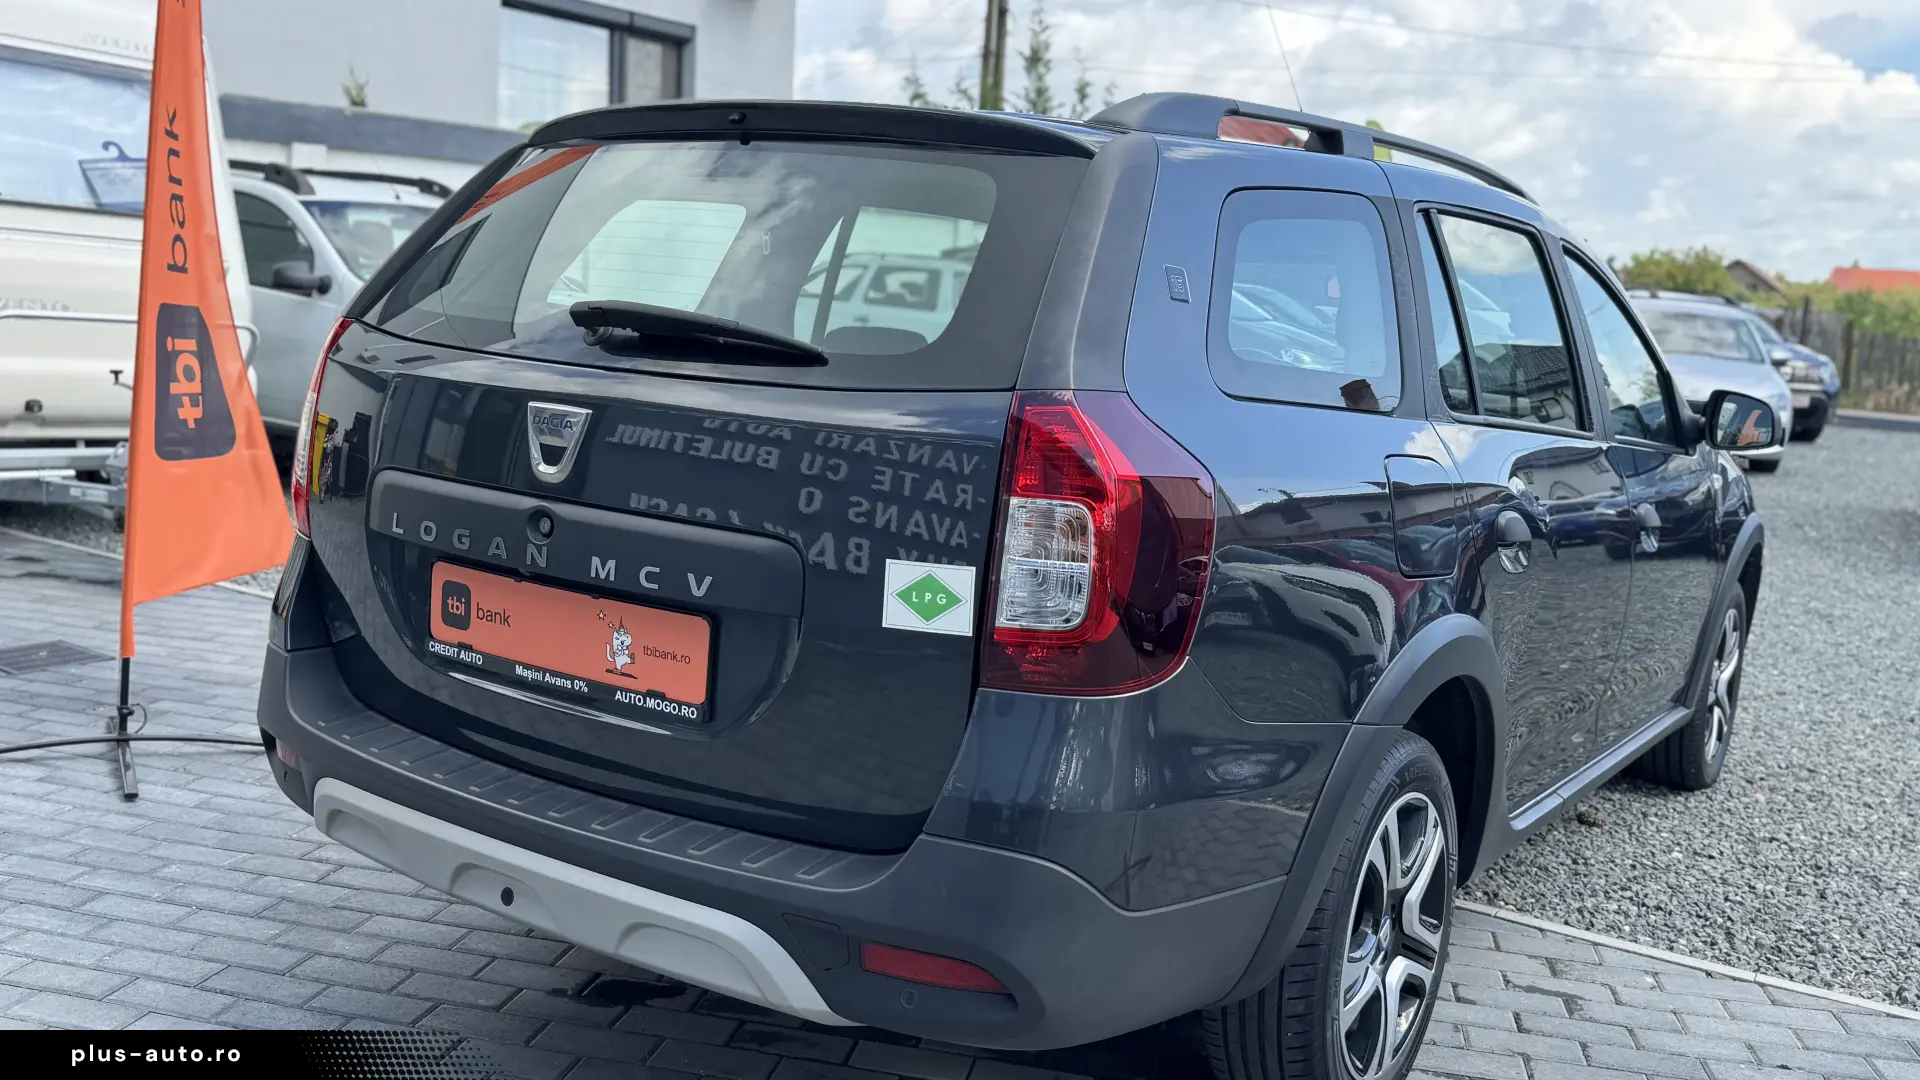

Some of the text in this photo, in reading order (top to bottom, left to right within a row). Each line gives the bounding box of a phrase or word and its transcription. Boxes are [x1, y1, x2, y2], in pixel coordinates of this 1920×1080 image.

[164, 103, 203, 429] tbi bank
[532, 414, 575, 432] DACIA
[391, 512, 714, 598] LOGAN MCV
[912, 590, 948, 605] LPG
[447, 596, 511, 628] tbi bank
[428, 641, 483, 665] CREDIT AUTO
[642, 644, 692, 665] tbibank.ro
[544, 672, 572, 689] Avans
[573, 679, 588, 693] 0%
[614, 690, 697, 719] AUTO.MOGO.RO
